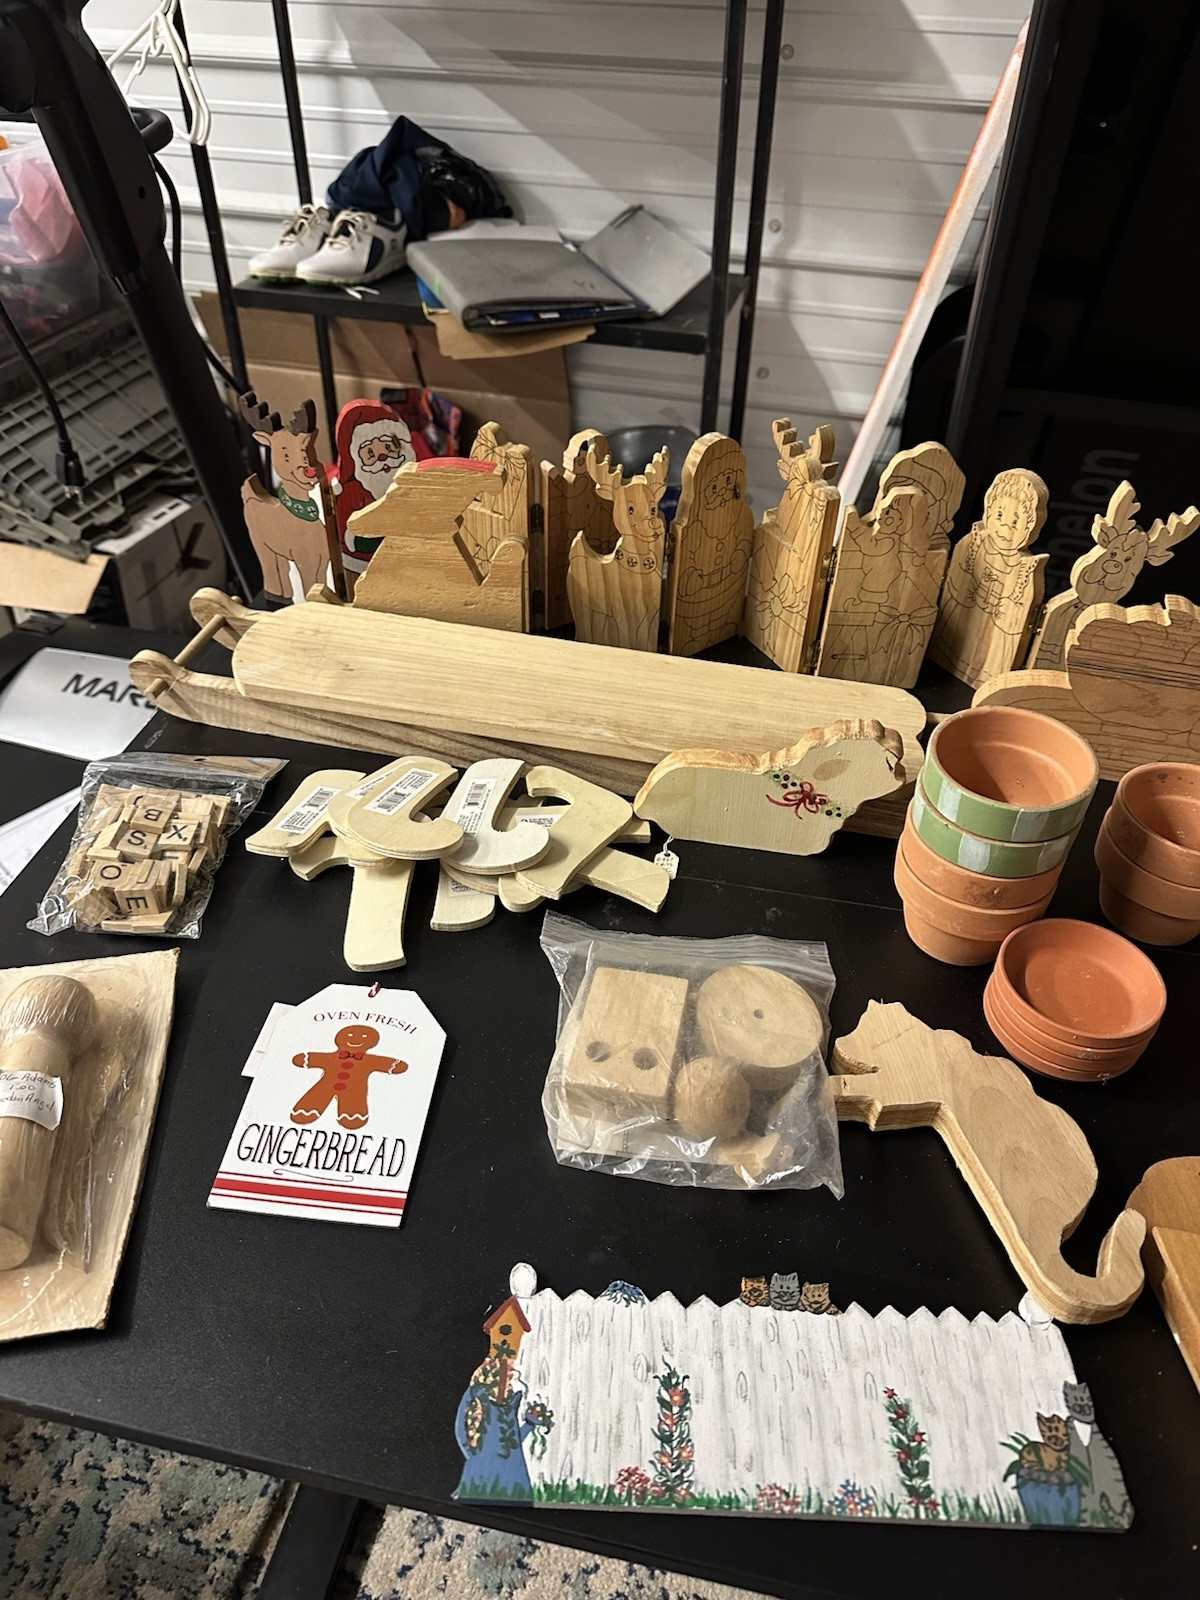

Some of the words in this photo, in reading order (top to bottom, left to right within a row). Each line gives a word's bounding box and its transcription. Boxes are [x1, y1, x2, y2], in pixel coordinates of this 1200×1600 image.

[127, 830, 147, 846] S
[166, 824, 188, 840] X
[125, 896, 149, 910] E
[313, 1011, 362, 1023] OVEN
[365, 1012, 418, 1035] FRESH
[236, 1123, 406, 1178] GINGERBREAD
